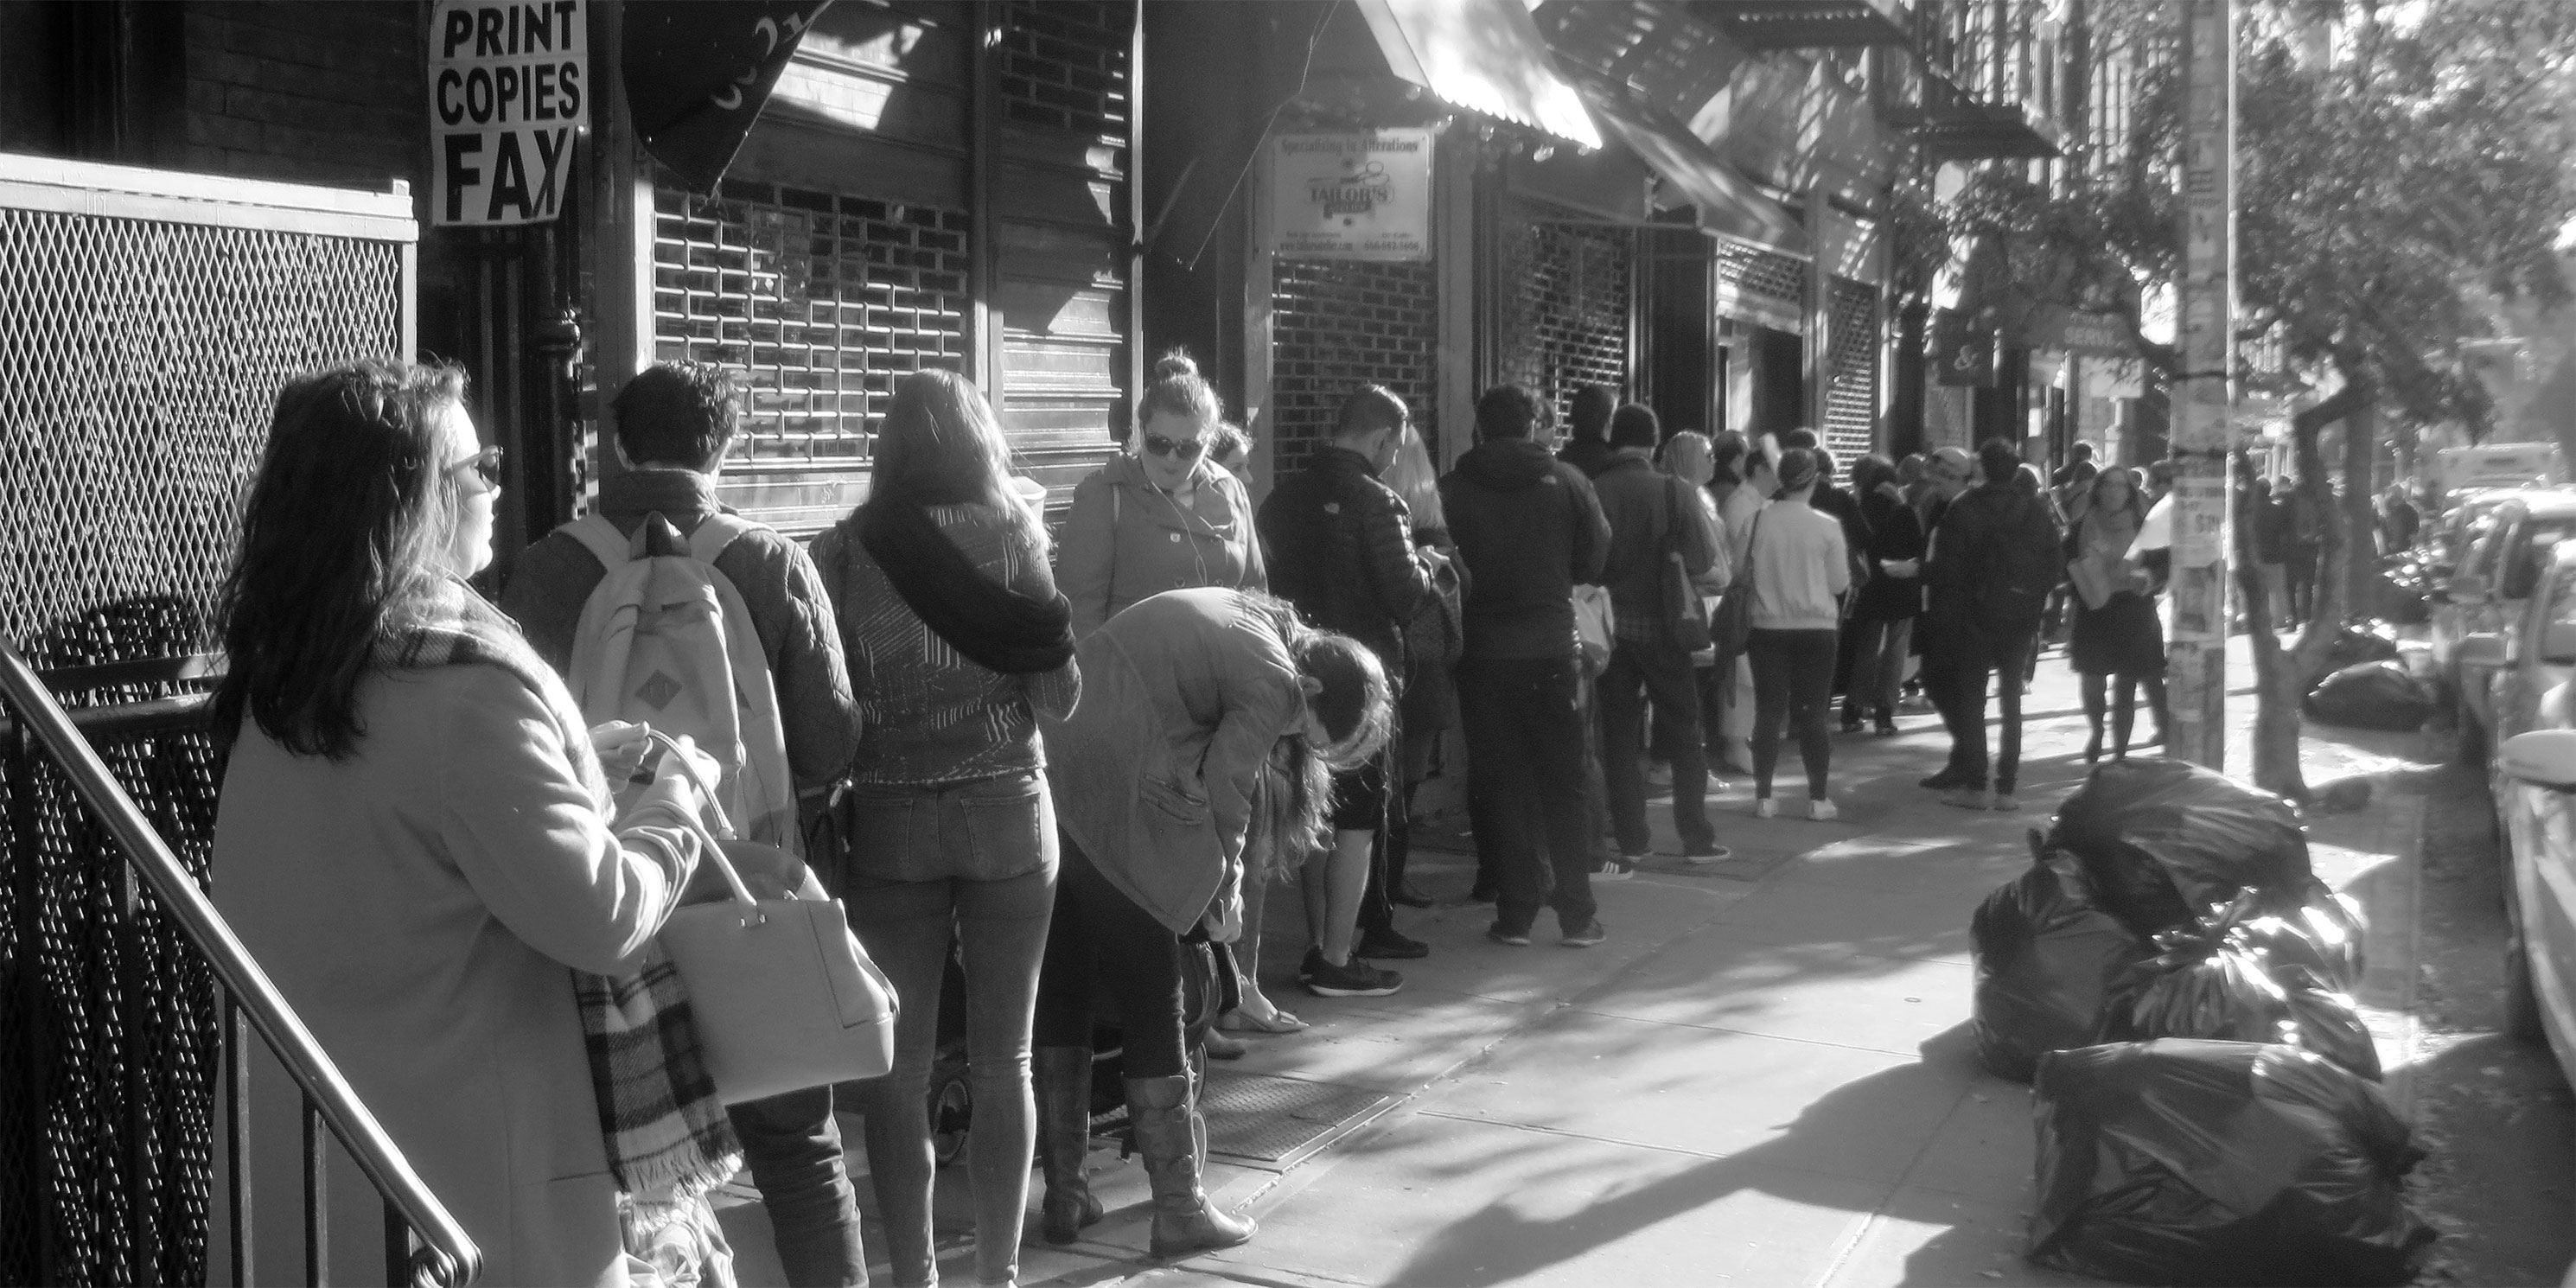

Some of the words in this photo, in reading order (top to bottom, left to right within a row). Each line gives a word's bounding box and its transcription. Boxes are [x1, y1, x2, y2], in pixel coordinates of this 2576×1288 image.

[443, 1, 577, 59] PRINT
[437, 61, 581, 126] COPIES
[443, 127, 569, 222] FAX
[1361, 137, 1419, 152] Alterations
